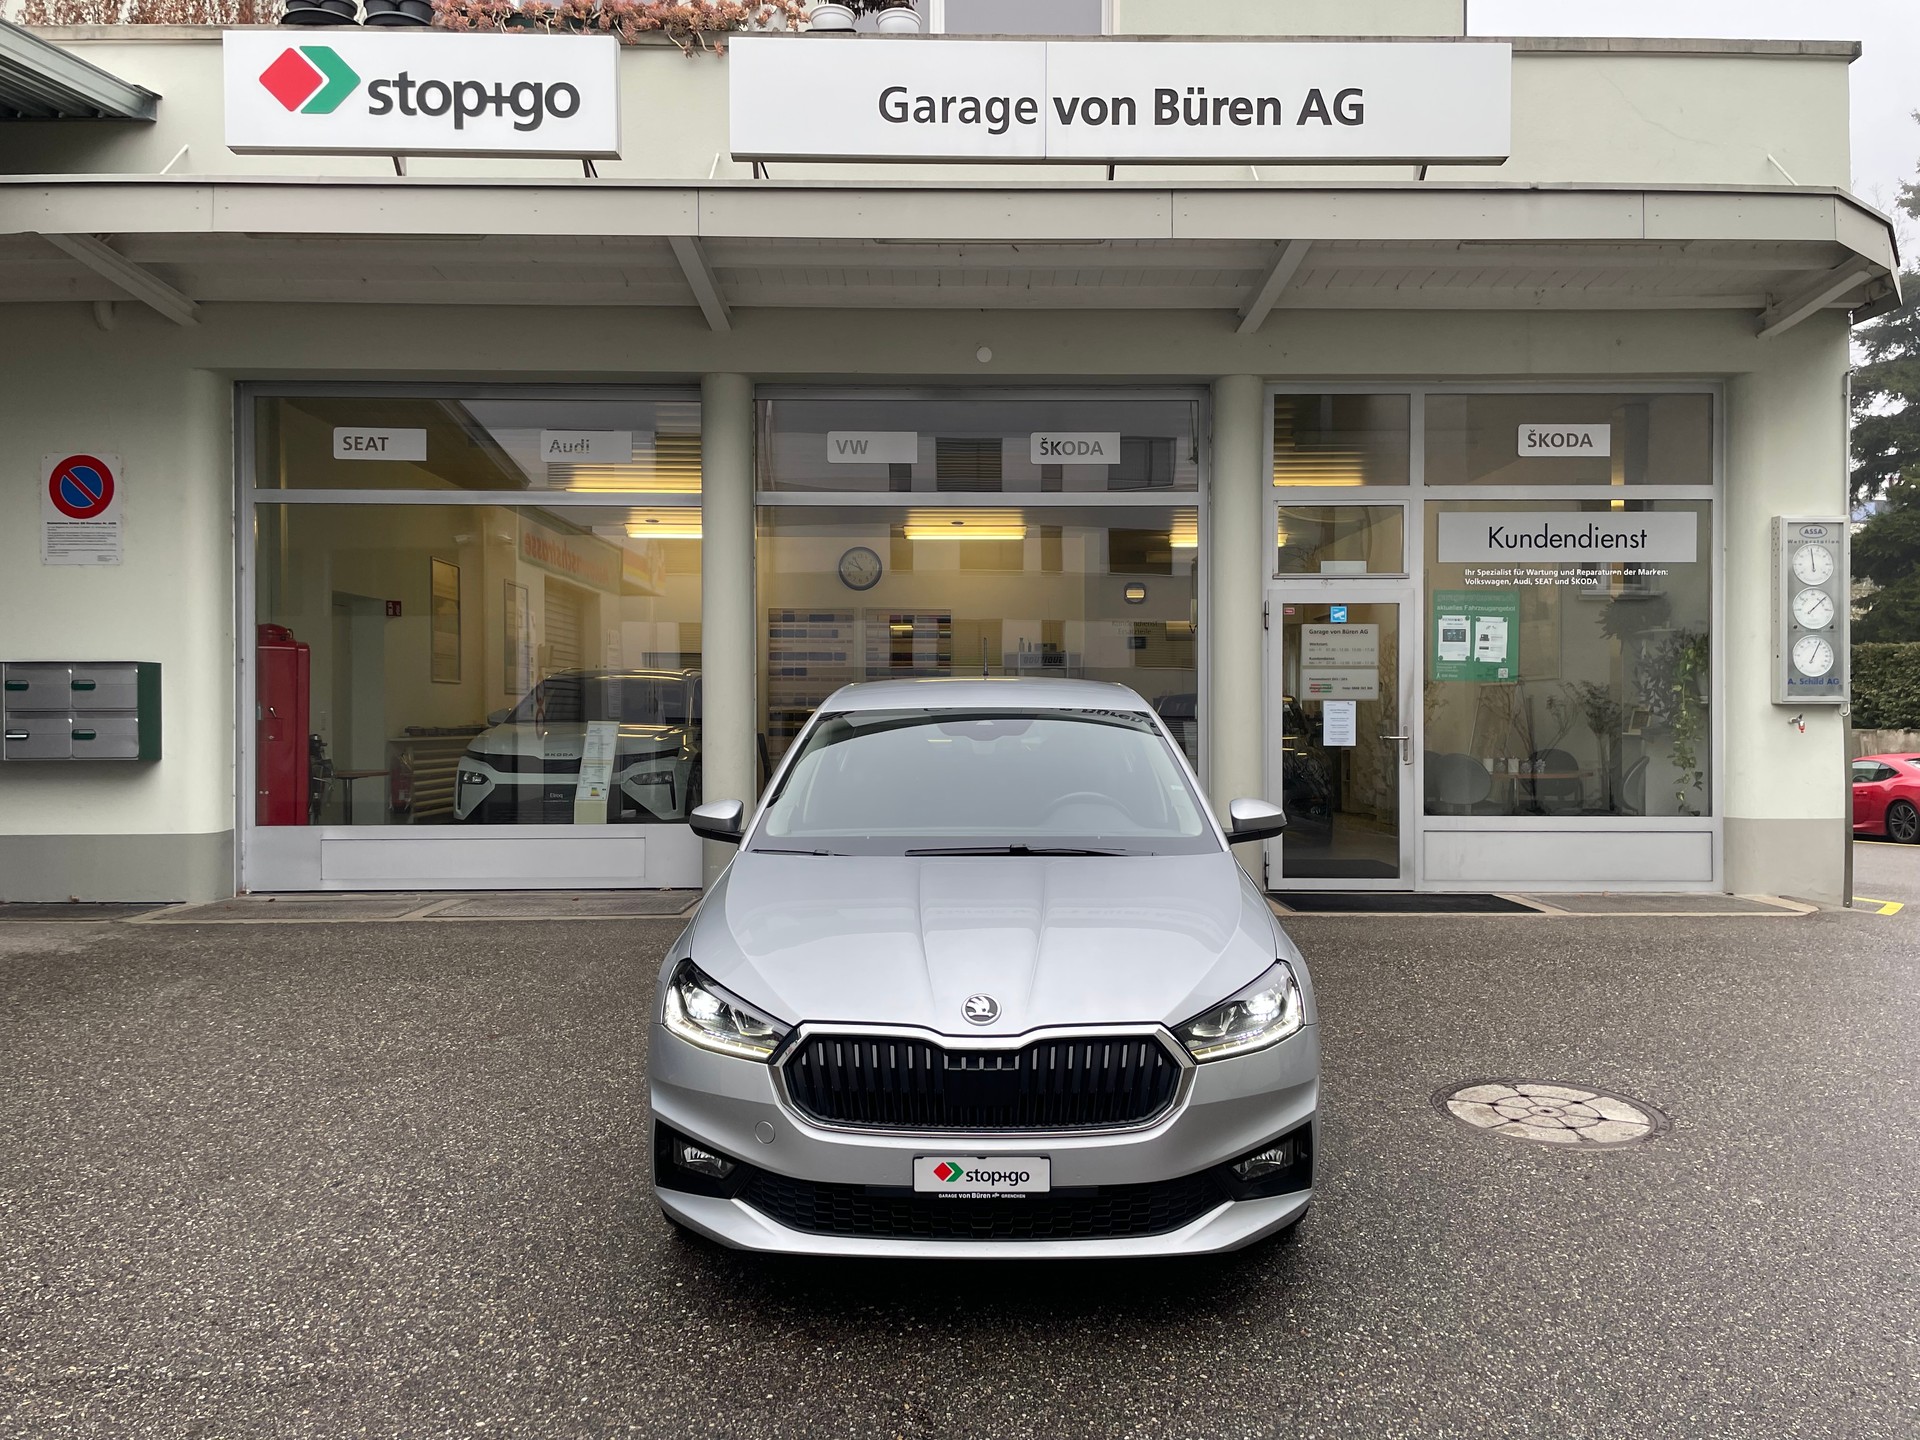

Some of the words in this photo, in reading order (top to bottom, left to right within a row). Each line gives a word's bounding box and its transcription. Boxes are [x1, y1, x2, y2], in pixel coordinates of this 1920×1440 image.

[367, 71, 581, 132] stop+go
[879, 86, 1039, 135] Garage
[1052, 96, 1137, 126] von
[1154, 87, 1282, 127] Büren
[1297, 88, 1364, 126] AG
[342, 436, 389, 452] SEAT
[549, 438, 590, 454] Audi
[835, 439, 869, 455] VW
[1039, 437, 1104, 456] ŠKODA
[1527, 430, 1594, 449] ŠKODA
[1488, 522, 1648, 550] Kundendienst
[1477, 569, 1512, 577] Spezialist
[1526, 569, 1558, 577] Wartung
[1576, 569, 1622, 577] Reparaturen
[1465, 578, 1512, 587] Volkswagen,
[1513, 578, 1533, 586] Audi,
[1571, 577, 1599, 585] ŠKODA
[1023, 656, 1064, 664] BOUTIQUE
[965, 1168, 1030, 1187] stop+go
